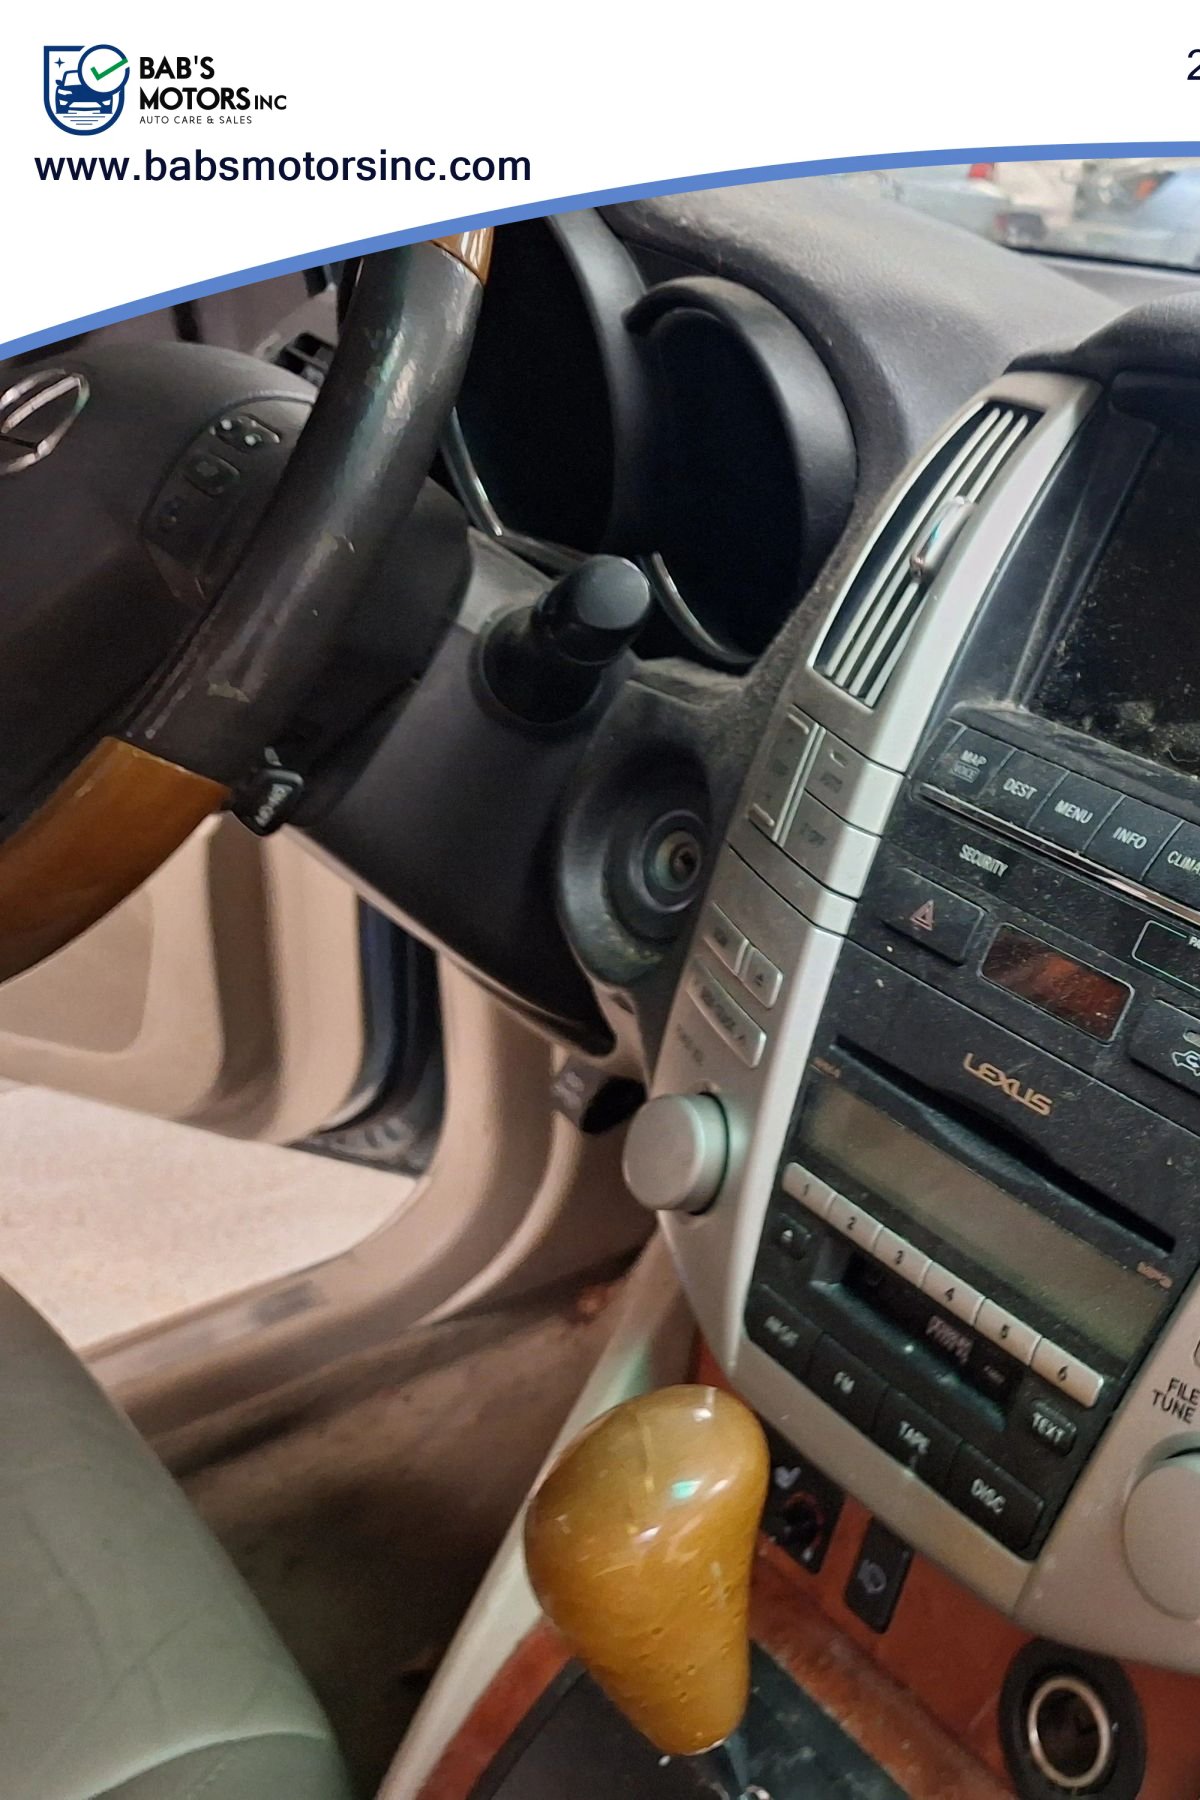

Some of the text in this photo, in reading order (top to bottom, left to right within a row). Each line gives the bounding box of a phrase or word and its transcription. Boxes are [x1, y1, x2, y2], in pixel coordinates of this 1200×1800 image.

[961, 750, 987, 767] MAP
[1003, 778, 1037, 800] DEST
[1054, 800, 1093, 825] MENU
[1113, 826, 1148, 849] INFO
[959, 843, 1008, 878] SECURITY
[962, 1052, 1053, 1116] LEXUS
[846, 1216, 857, 1231] 2
[944, 1287, 956, 1302] 4
[1057, 1366, 1069, 1382] 6
[1167, 1377, 1200, 1406] FILE
[1152, 1389, 1196, 1425] TUNE
[1032, 1412, 1067, 1444] TEXT
[971, 1478, 1006, 1513] DISC
